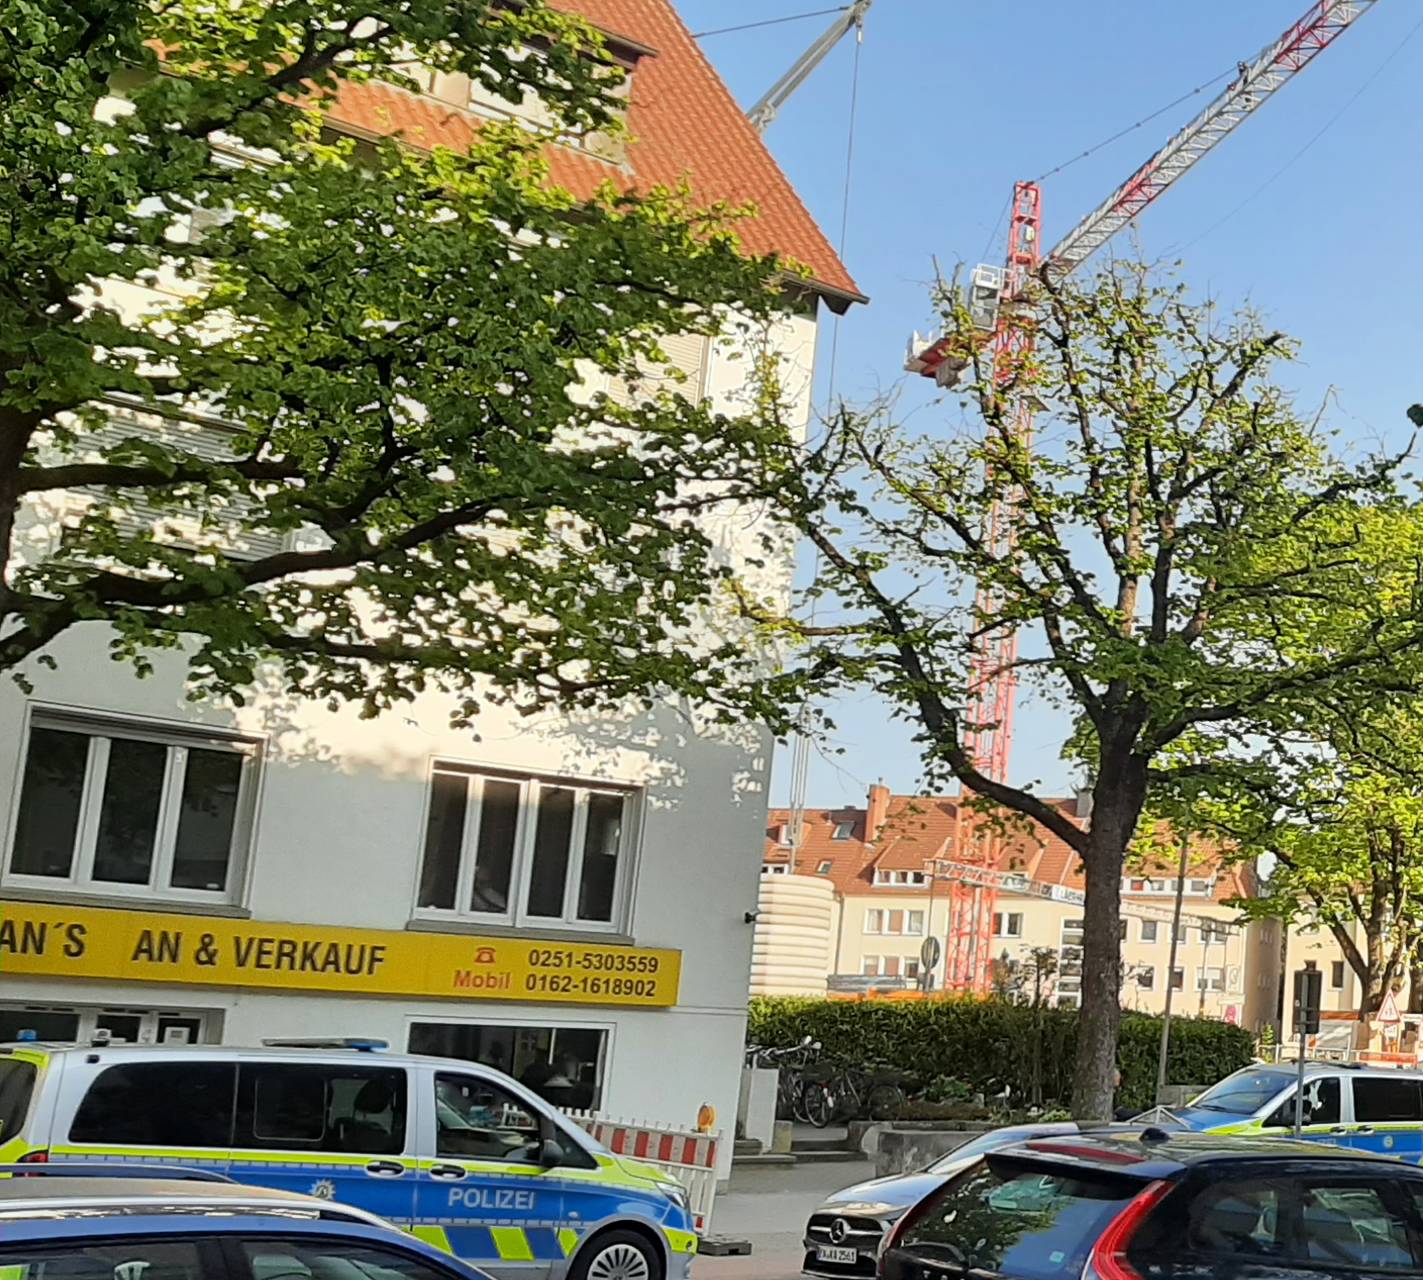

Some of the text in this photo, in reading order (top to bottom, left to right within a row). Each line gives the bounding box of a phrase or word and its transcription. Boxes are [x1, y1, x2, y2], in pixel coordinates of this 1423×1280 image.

[131, 929, 183, 963] AN
[195, 933, 218, 966] &
[233, 935, 387, 976] VERKAUF
[529, 949, 659, 973] 0251-5303559
[453, 969, 656, 997] Mobil 0162-1618902
[447, 1187, 536, 1210] POLIZEI
